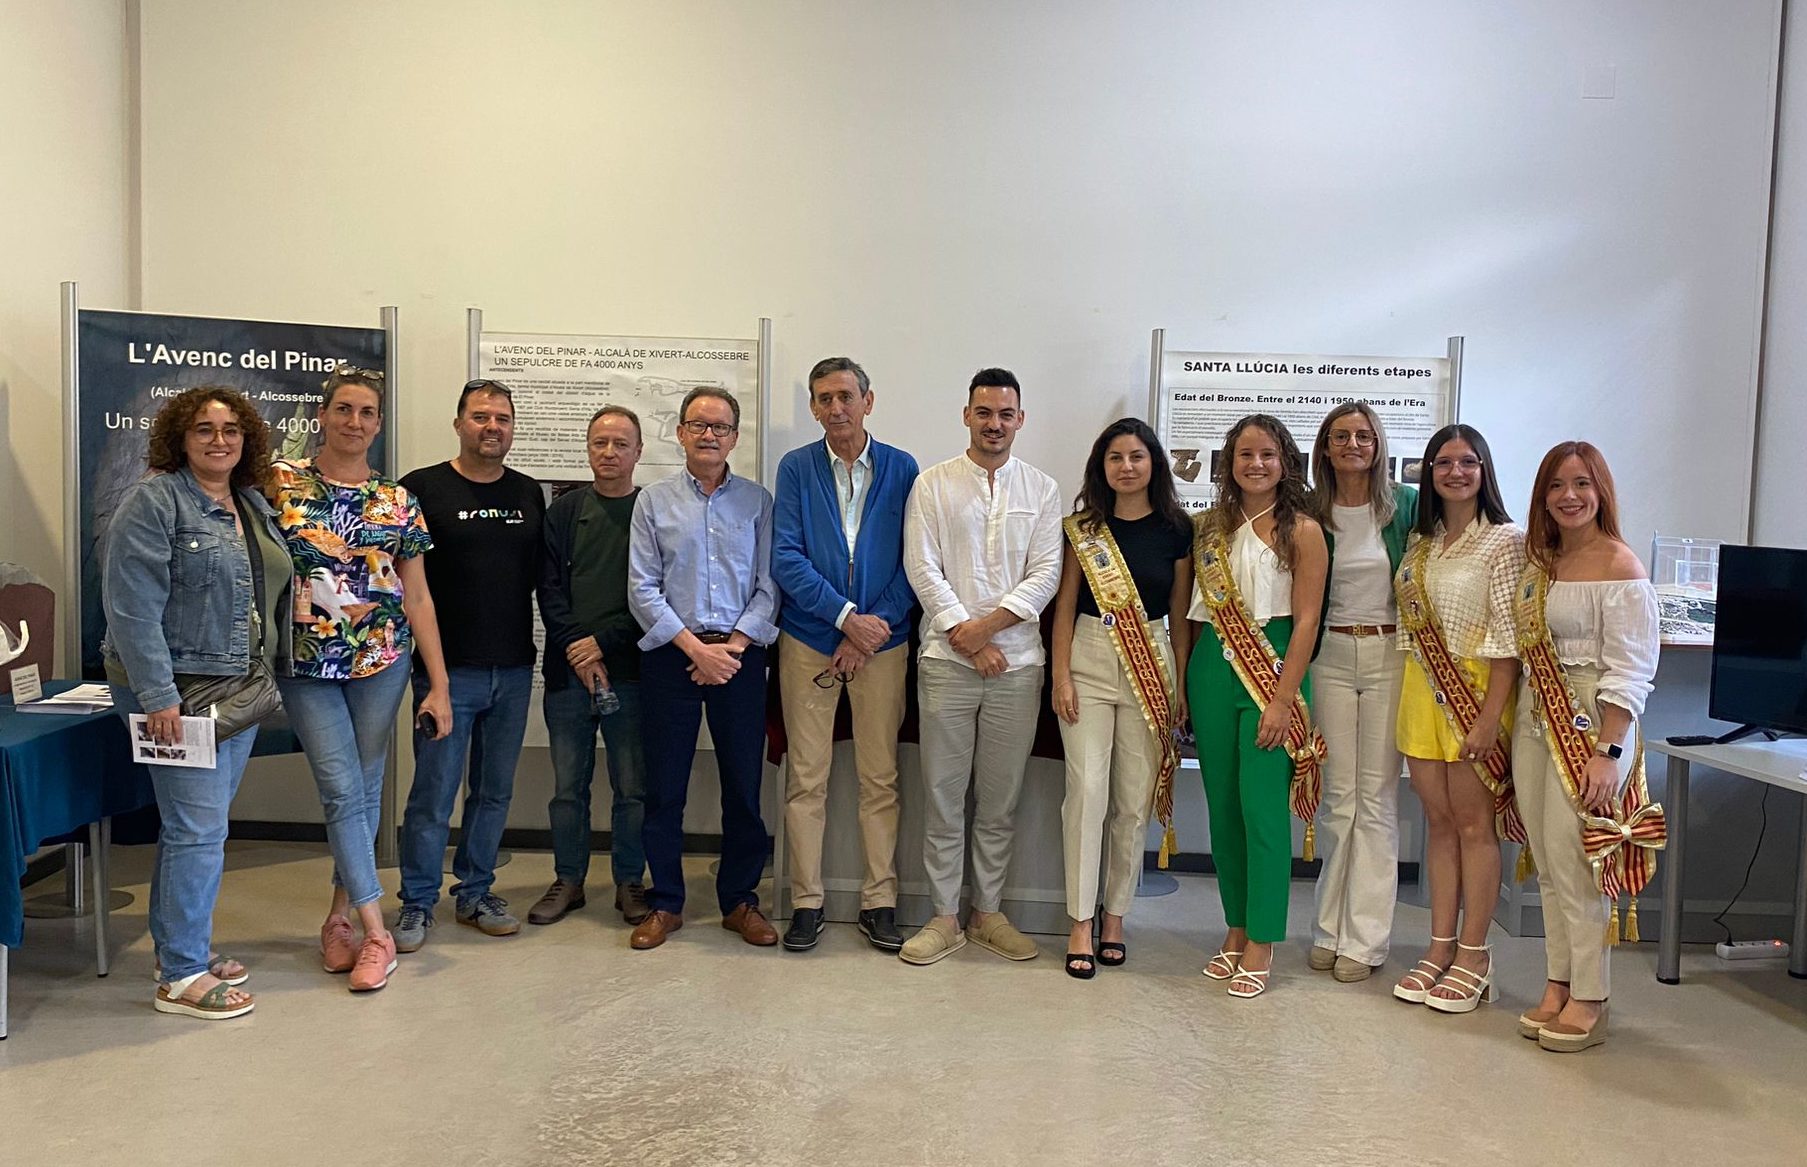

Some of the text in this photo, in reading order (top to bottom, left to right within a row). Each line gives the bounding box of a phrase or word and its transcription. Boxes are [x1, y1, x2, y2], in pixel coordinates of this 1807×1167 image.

[128, 343, 233, 368] L'Avenc
[239, 349, 276, 370] del
[494, 345, 534, 355] L'AVENC
[536, 346, 555, 356] DEL
[557, 347, 586, 356] PINAR
[594, 347, 630, 358] ALCALÀ
[633, 349, 646, 358] DE
[648, 350, 750, 361] XIVERT-ALCOSSEBRE
[494, 357, 644, 370] UN SEPULCRE DE FA 4000 ANYS
[1184, 360, 1432, 379] SANTA LLÚCIA les diferents etapes
[1174, 393, 1197, 401] Edat
[1199, 394, 1214, 402] del
[1217, 394, 1254, 403] Bronze.
[1257, 395, 1283, 403] Entre
[1286, 396, 1295, 404] el
[1298, 396, 1322, 404] 2140
[1324, 396, 1327, 404] i
[1389, 398, 1401, 406] de
[1404, 399, 1426, 407] l'Era
[105, 412, 133, 430] Un
[276, 417, 321, 434] 4000
